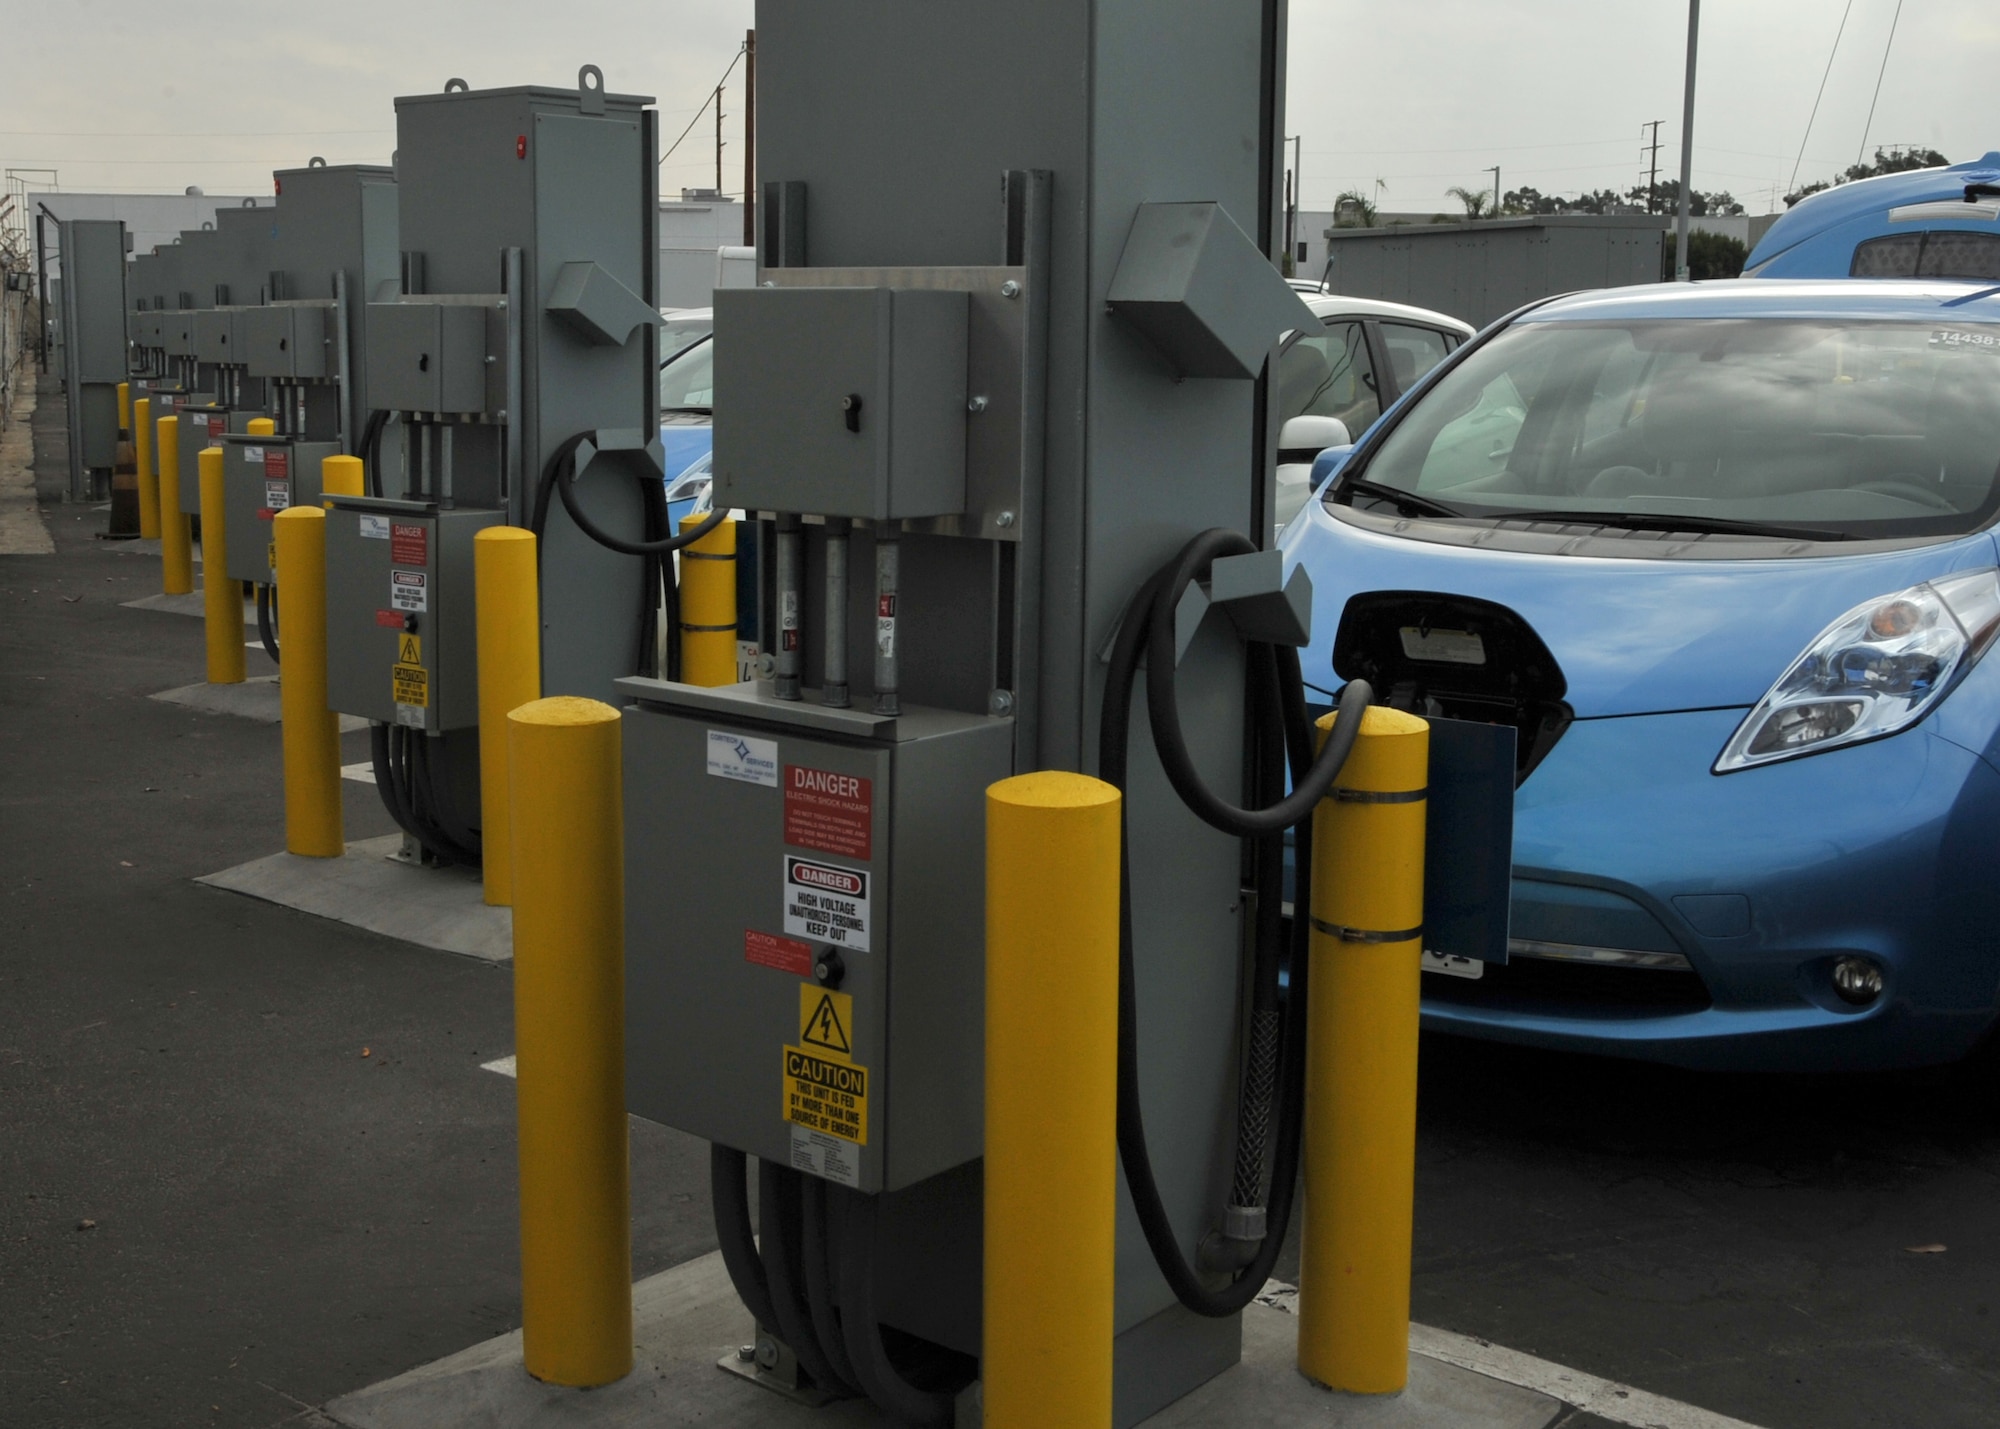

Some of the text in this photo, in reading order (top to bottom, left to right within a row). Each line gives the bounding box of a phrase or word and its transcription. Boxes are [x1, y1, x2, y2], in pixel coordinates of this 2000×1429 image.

[395, 525, 422, 538] DANGER
[395, 669, 425, 683] CAUTION
[746, 757, 774, 769] SERVICES
[795, 768, 859, 799] DANGER
[786, 791, 869, 813] ELECTRIC SHOCK HAZARD
[801, 868, 852, 890] DANGER
[798, 892, 856, 916] HIGH VOLTAGE
[789, 903, 865, 933] UNAUTHORIZED PERSONNEL
[746, 931, 777, 946] CAUTION
[806, 921, 846, 942] KEEP OUT
[790, 1055, 862, 1093] CAUTION
[796, 1080, 854, 1109] THIS UNIT IS FED
[791, 1093, 860, 1126] BY MORE THAN ONE
[791, 1108, 860, 1141] SOURCE OF ENERGY
